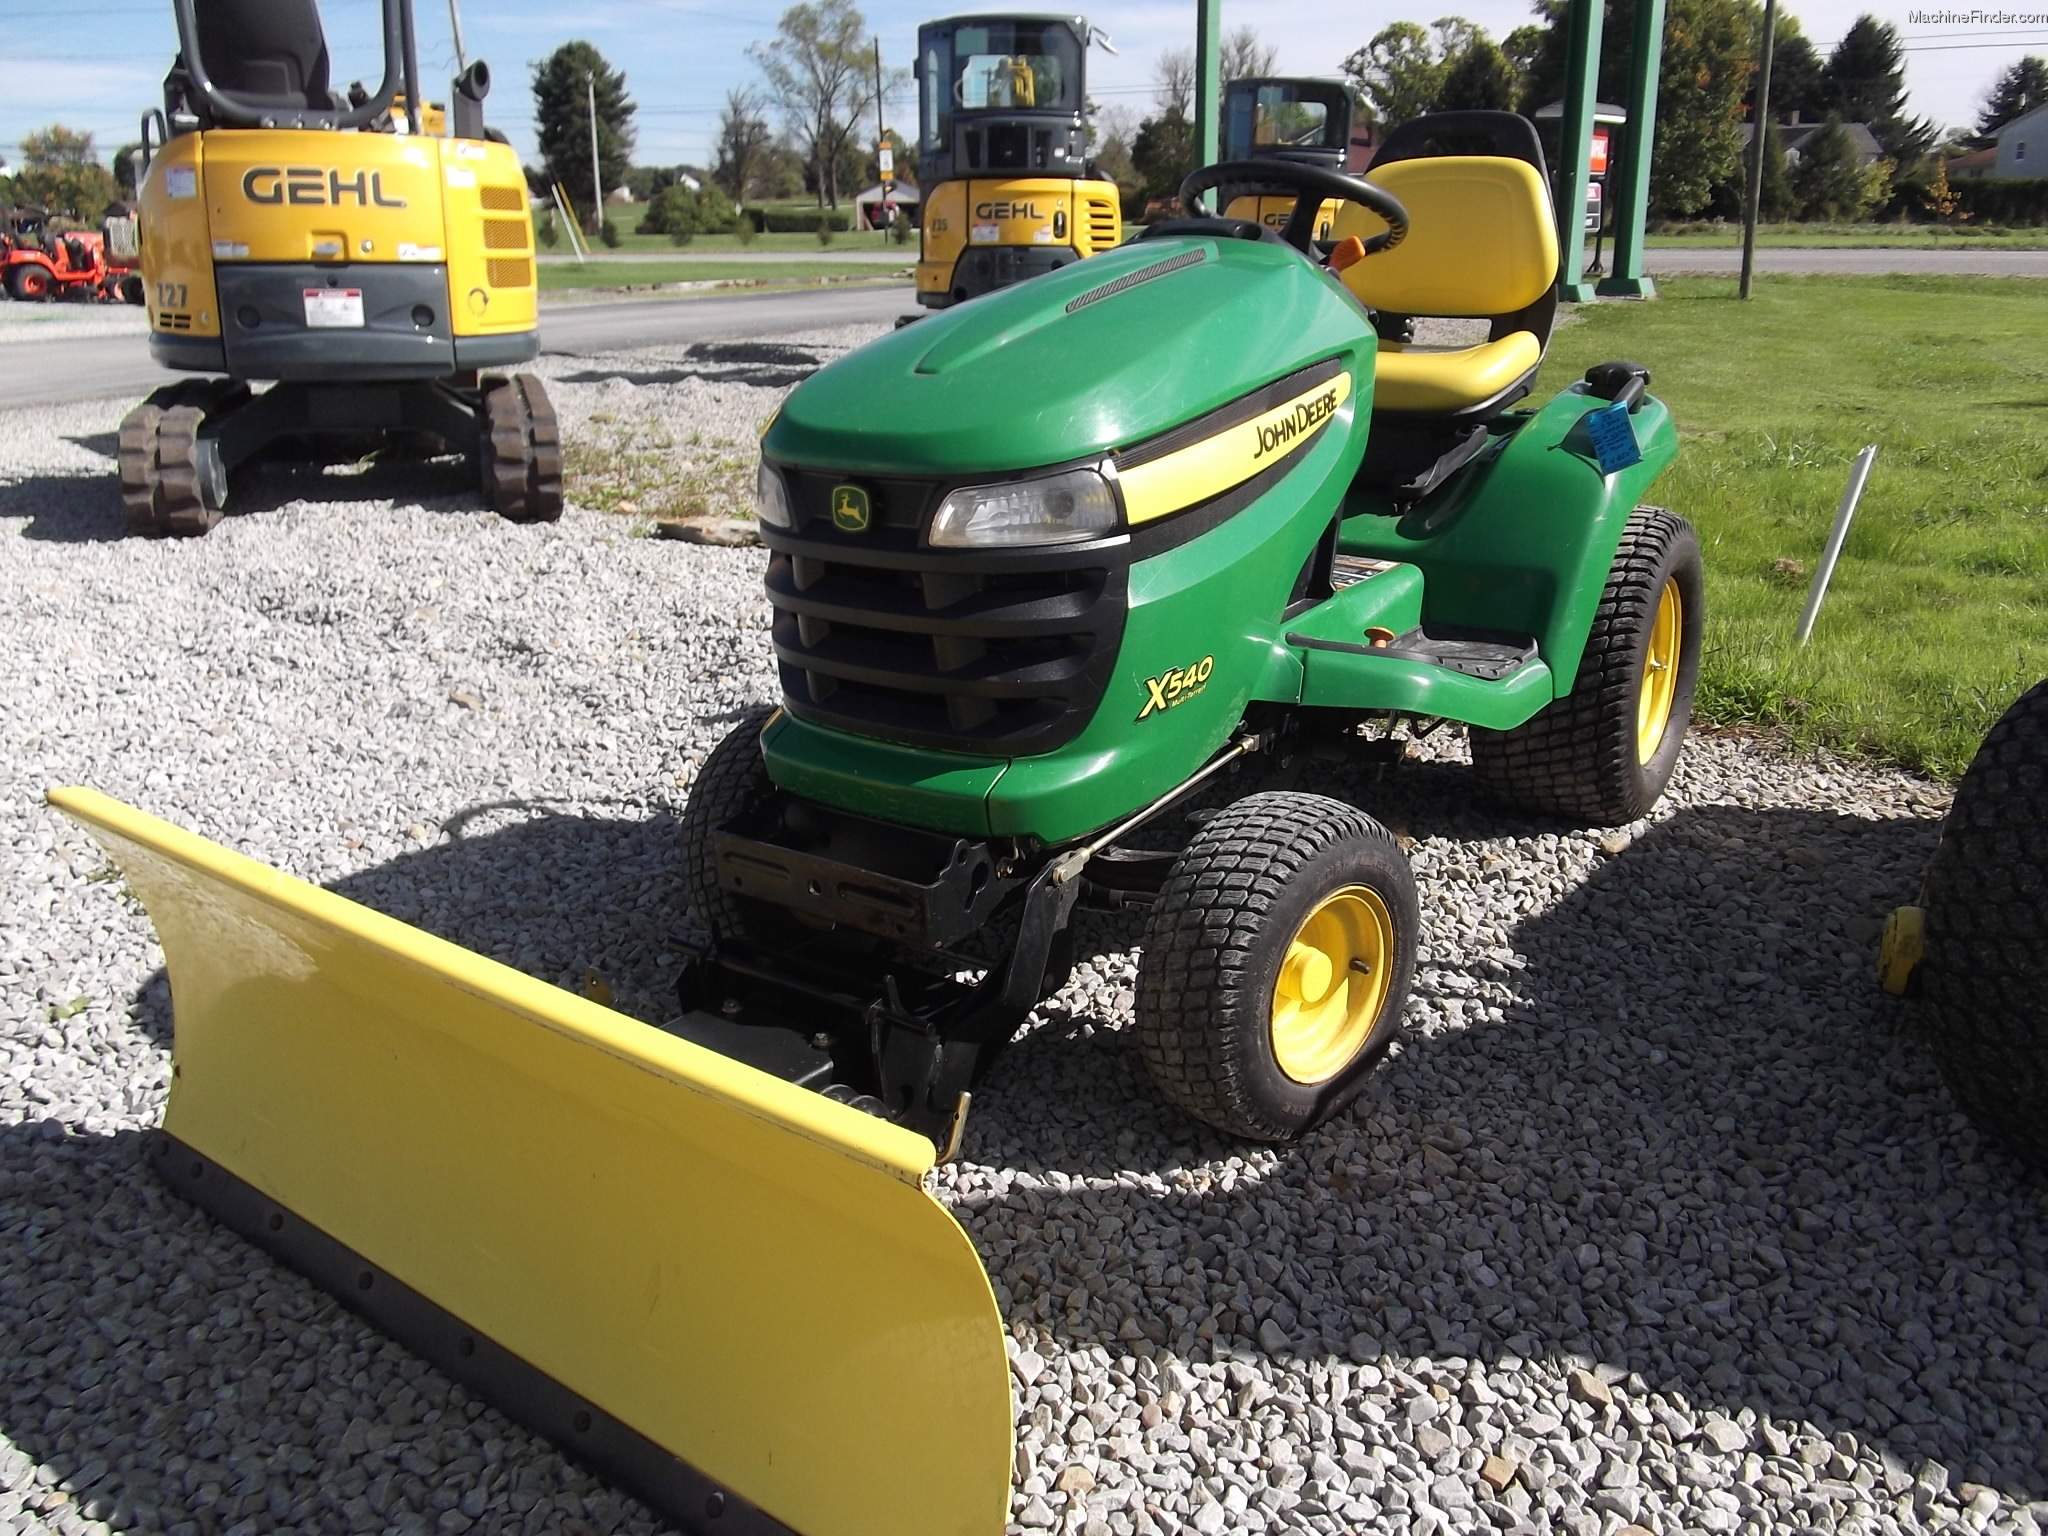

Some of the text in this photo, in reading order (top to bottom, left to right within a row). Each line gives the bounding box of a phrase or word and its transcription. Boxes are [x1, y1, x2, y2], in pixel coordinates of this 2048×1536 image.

[243, 167, 408, 209] GEHL
[975, 202, 1045, 220] GEHL
[1264, 213, 1291, 225] GE
[1253, 386, 1338, 460] JOHN DEERE
[1135, 654, 1214, 722] X540
